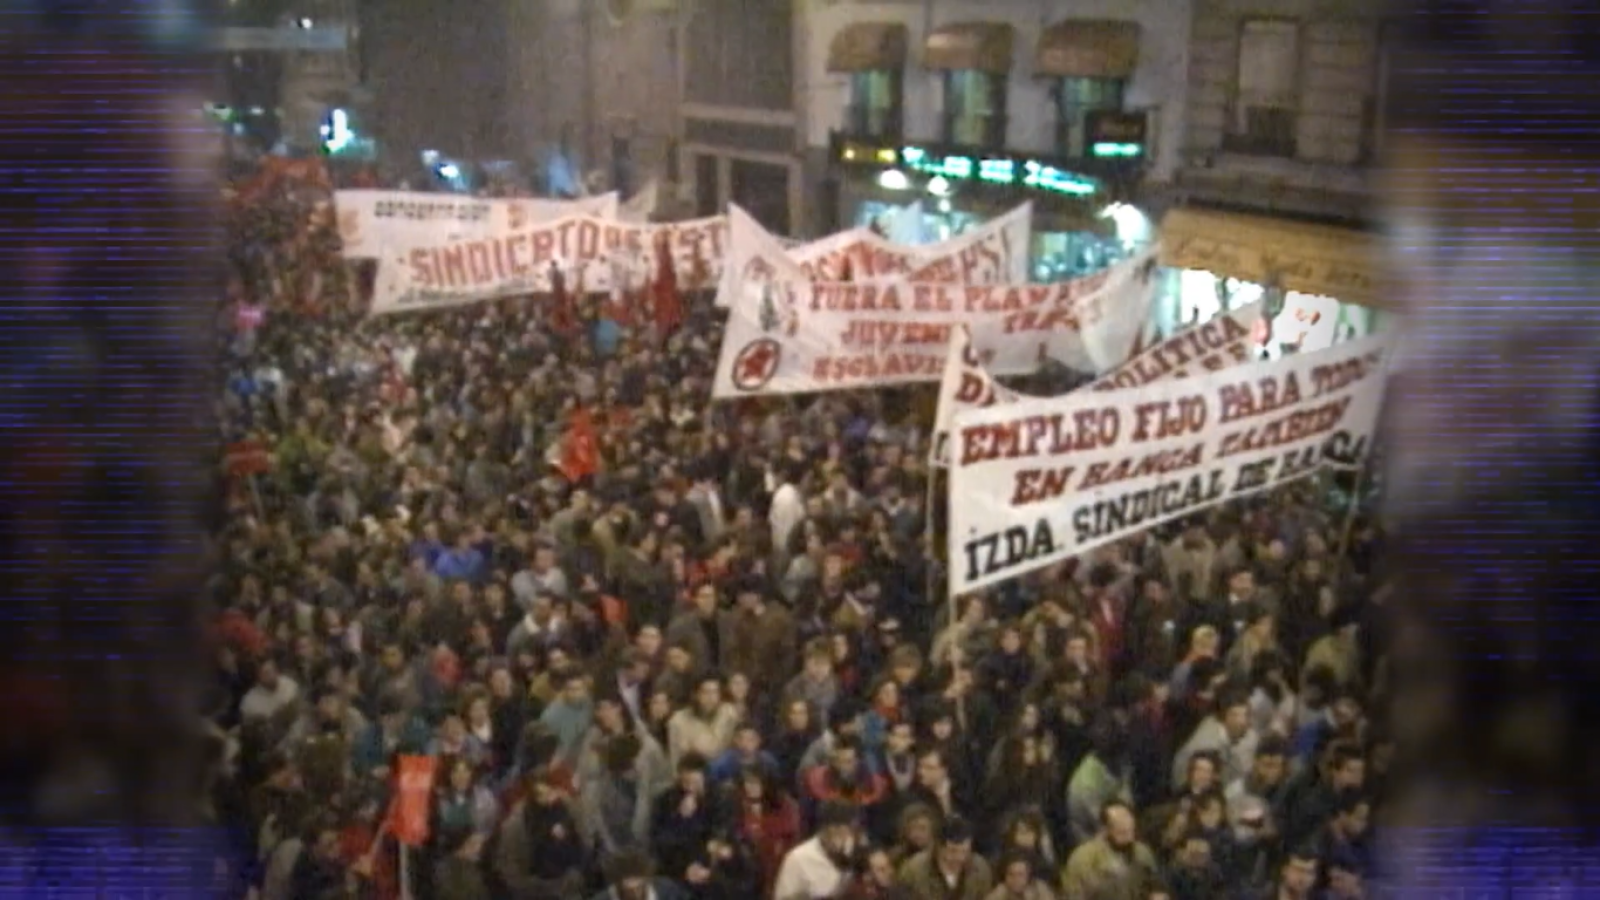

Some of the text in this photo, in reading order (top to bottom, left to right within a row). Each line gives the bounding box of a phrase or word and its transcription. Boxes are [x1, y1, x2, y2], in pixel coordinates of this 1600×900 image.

[408, 219, 600, 288] SINDICATO
[810, 283, 901, 311] FUERA
[914, 284, 952, 311] EL
[840, 319, 950, 347] JUVENI
[960, 407, 1120, 467] EMPLEO
[1131, 394, 1207, 442] FIJO
[1219, 370, 1301, 424] PARA
[1011, 466, 1075, 506] EN
[1078, 443, 1202, 491] BANCA
[1073, 468, 1224, 544] SINDICAL
[1232, 457, 1277, 491] DE
